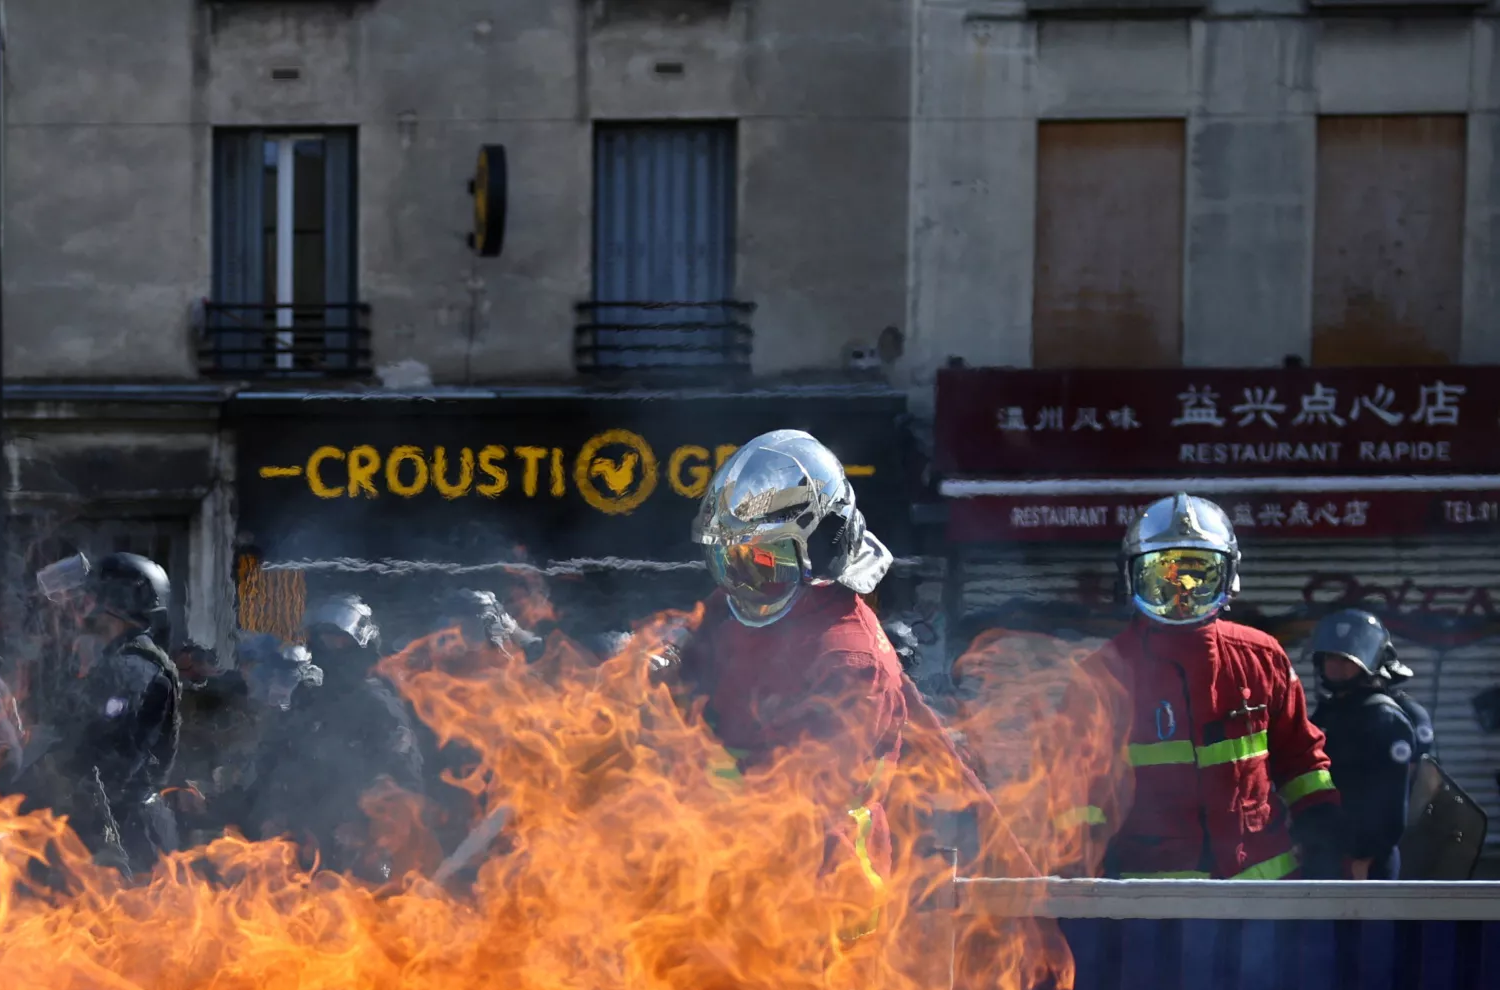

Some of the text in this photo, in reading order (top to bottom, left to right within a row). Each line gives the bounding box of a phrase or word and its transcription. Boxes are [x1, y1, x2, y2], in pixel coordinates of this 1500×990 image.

[1171, 379, 1467, 431] 益兴点心店
[1179, 441, 1452, 464] RESTAURANT RAPIDE
[305, 444, 565, 500] CROUSTI
[1011, 505, 1109, 527] RESTAURANT
